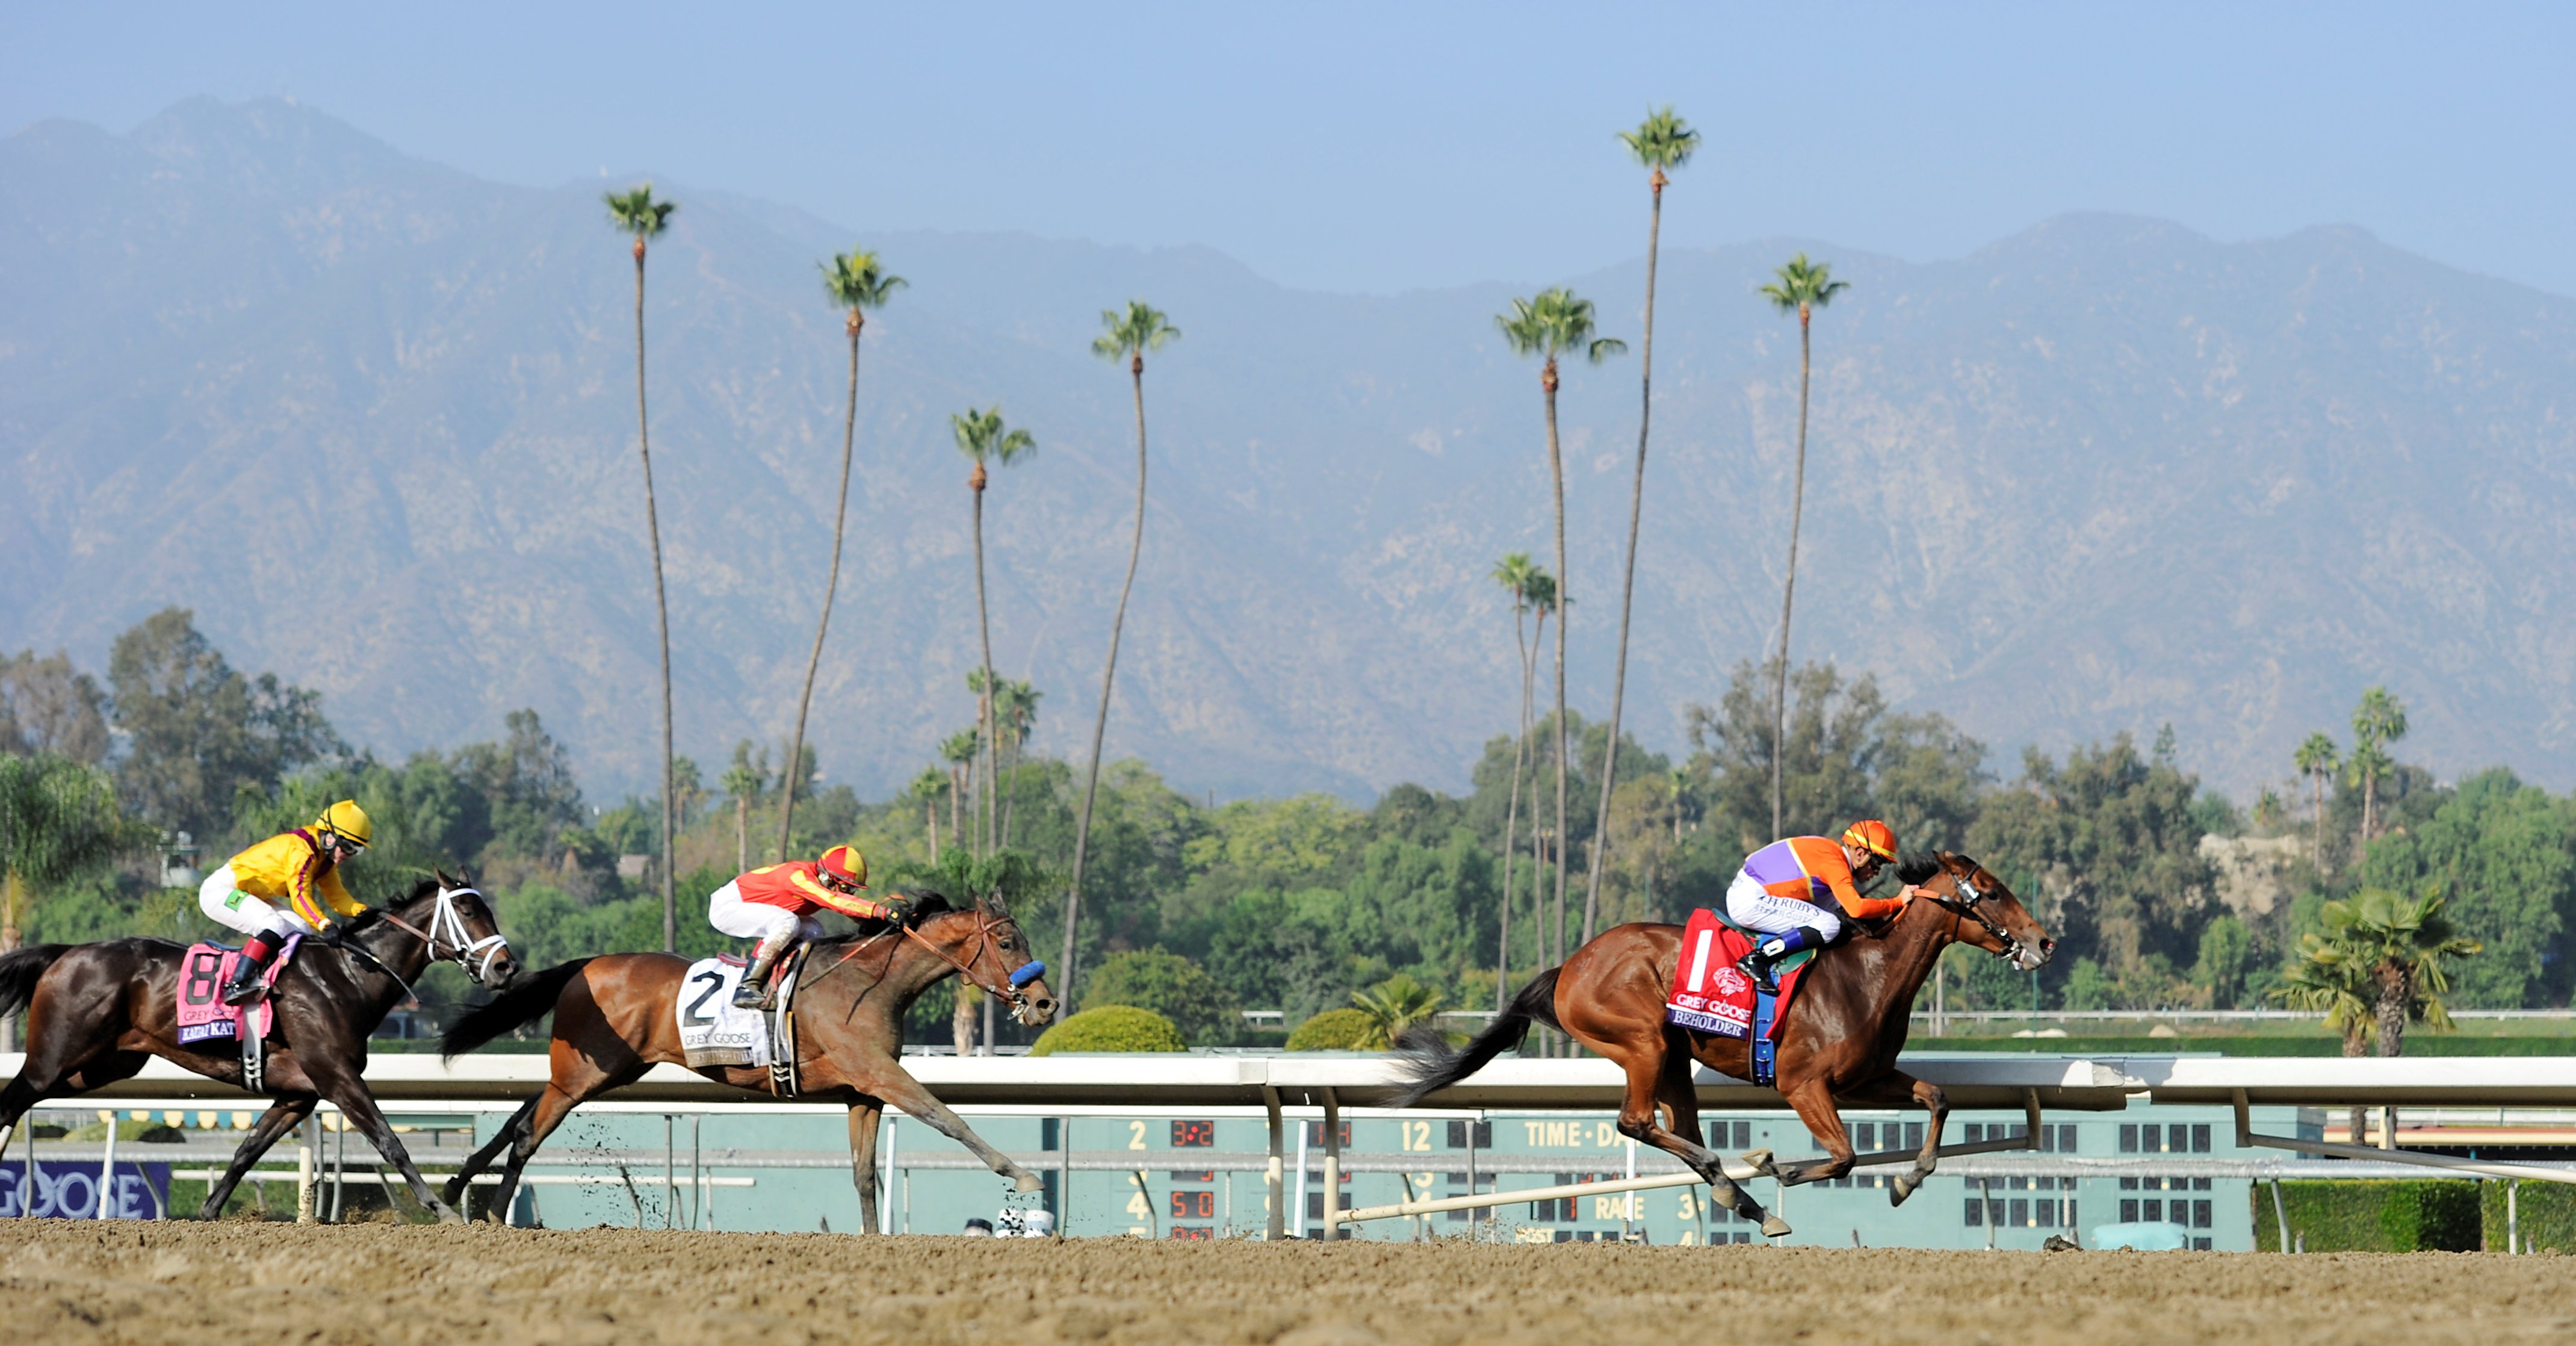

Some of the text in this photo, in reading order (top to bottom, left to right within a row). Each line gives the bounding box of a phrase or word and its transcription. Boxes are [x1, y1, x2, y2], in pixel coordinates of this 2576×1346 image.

[1780, 899, 1820, 916] RUBY'S
[1687, 929, 1713, 992] 1
[185, 953, 223, 1005] 8
[683, 970, 725, 1027] 2
[1676, 994, 1751, 1020] GREY GOOSE
[184, 1010, 210, 1022] GREY
[1673, 1011, 1742, 1037] BEHOLDER
[685, 1033, 751, 1046] GREY GOOSE
[1129, 1120, 1146, 1150] 2
[1402, 1121, 1431, 1152] 12
[1126, 1191, 1150, 1221] 4
